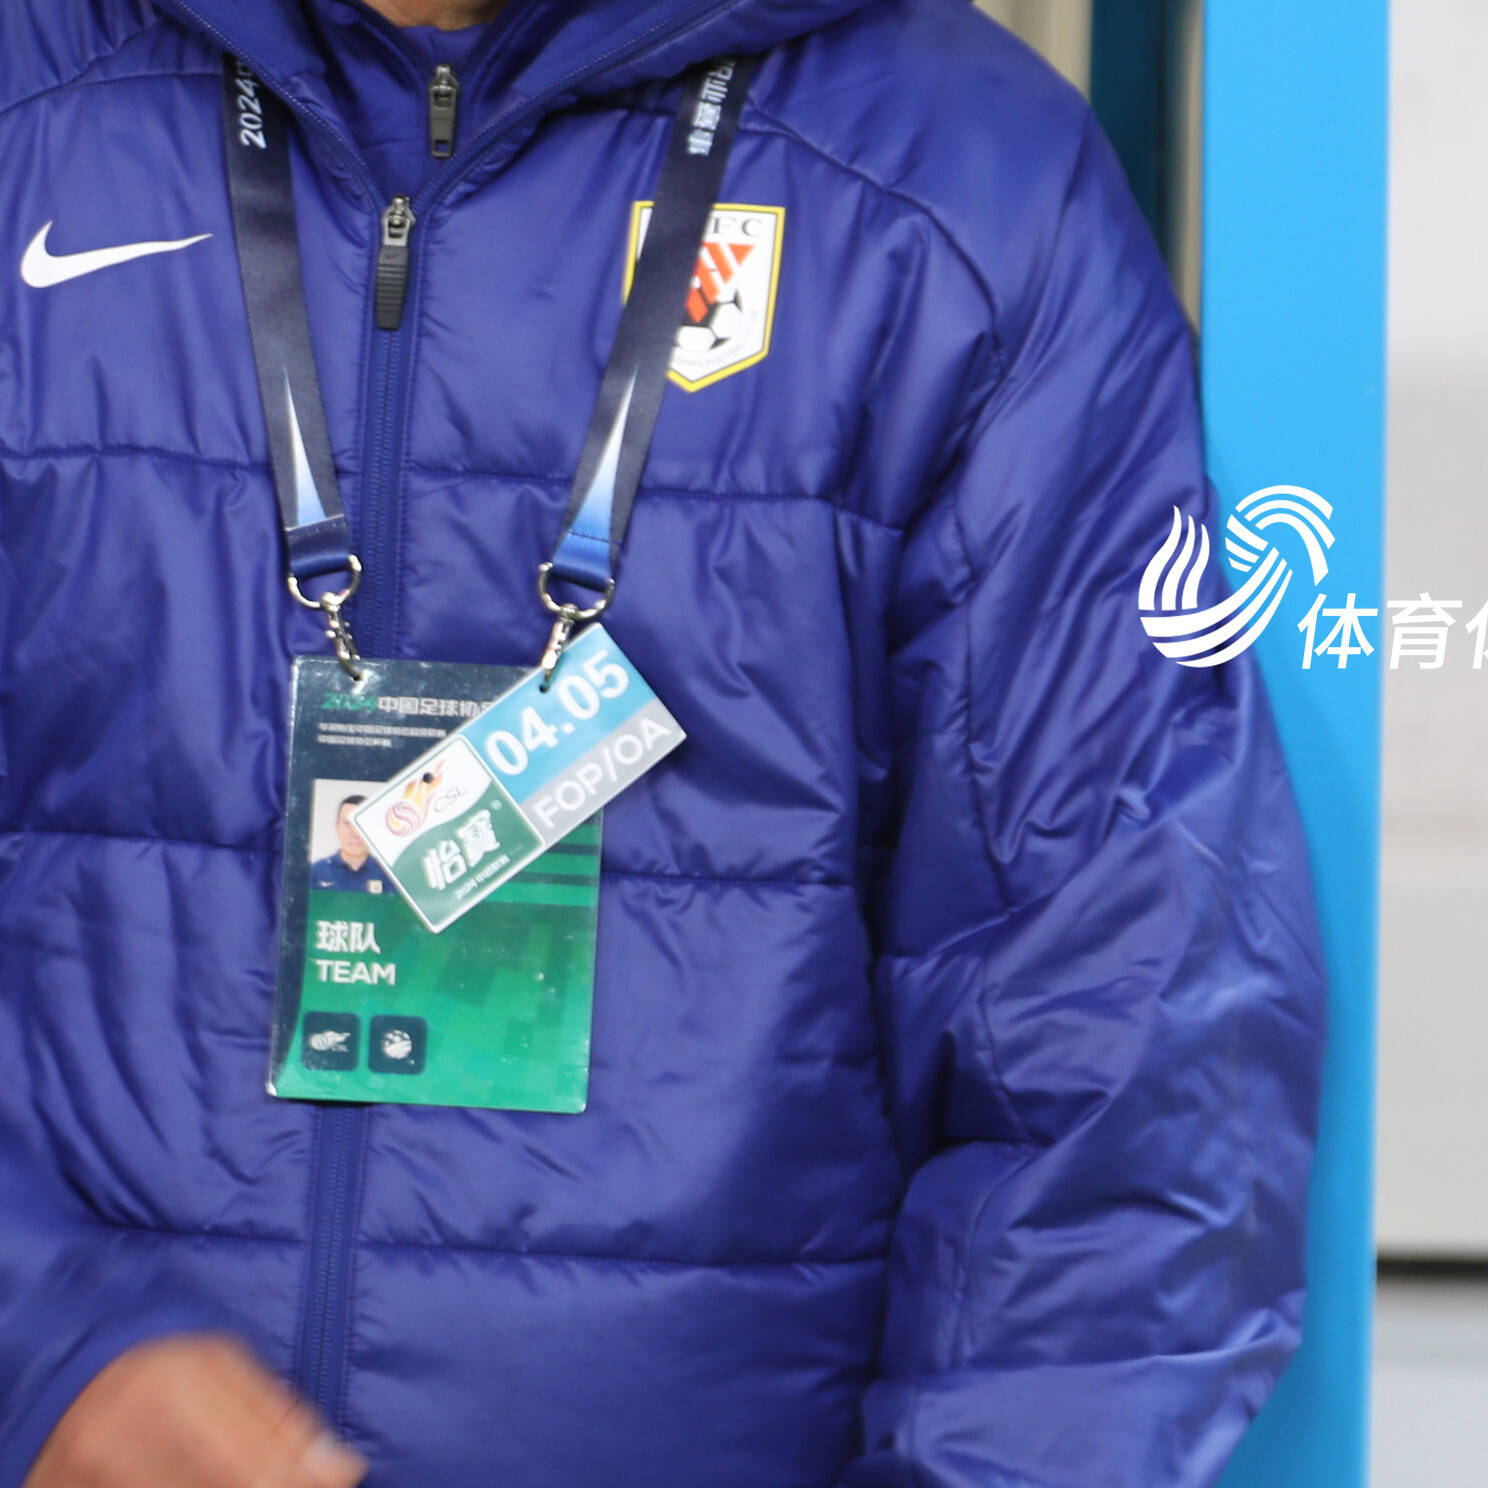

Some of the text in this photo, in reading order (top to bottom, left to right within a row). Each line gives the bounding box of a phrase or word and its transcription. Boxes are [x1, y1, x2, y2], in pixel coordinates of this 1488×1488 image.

[484, 650, 630, 776] 04.05
[532, 718, 672, 829] FOP/OA
[432, 784, 469, 813] CSL
[315, 920, 381, 955] 球队
[315, 959, 396, 985] TEAM
